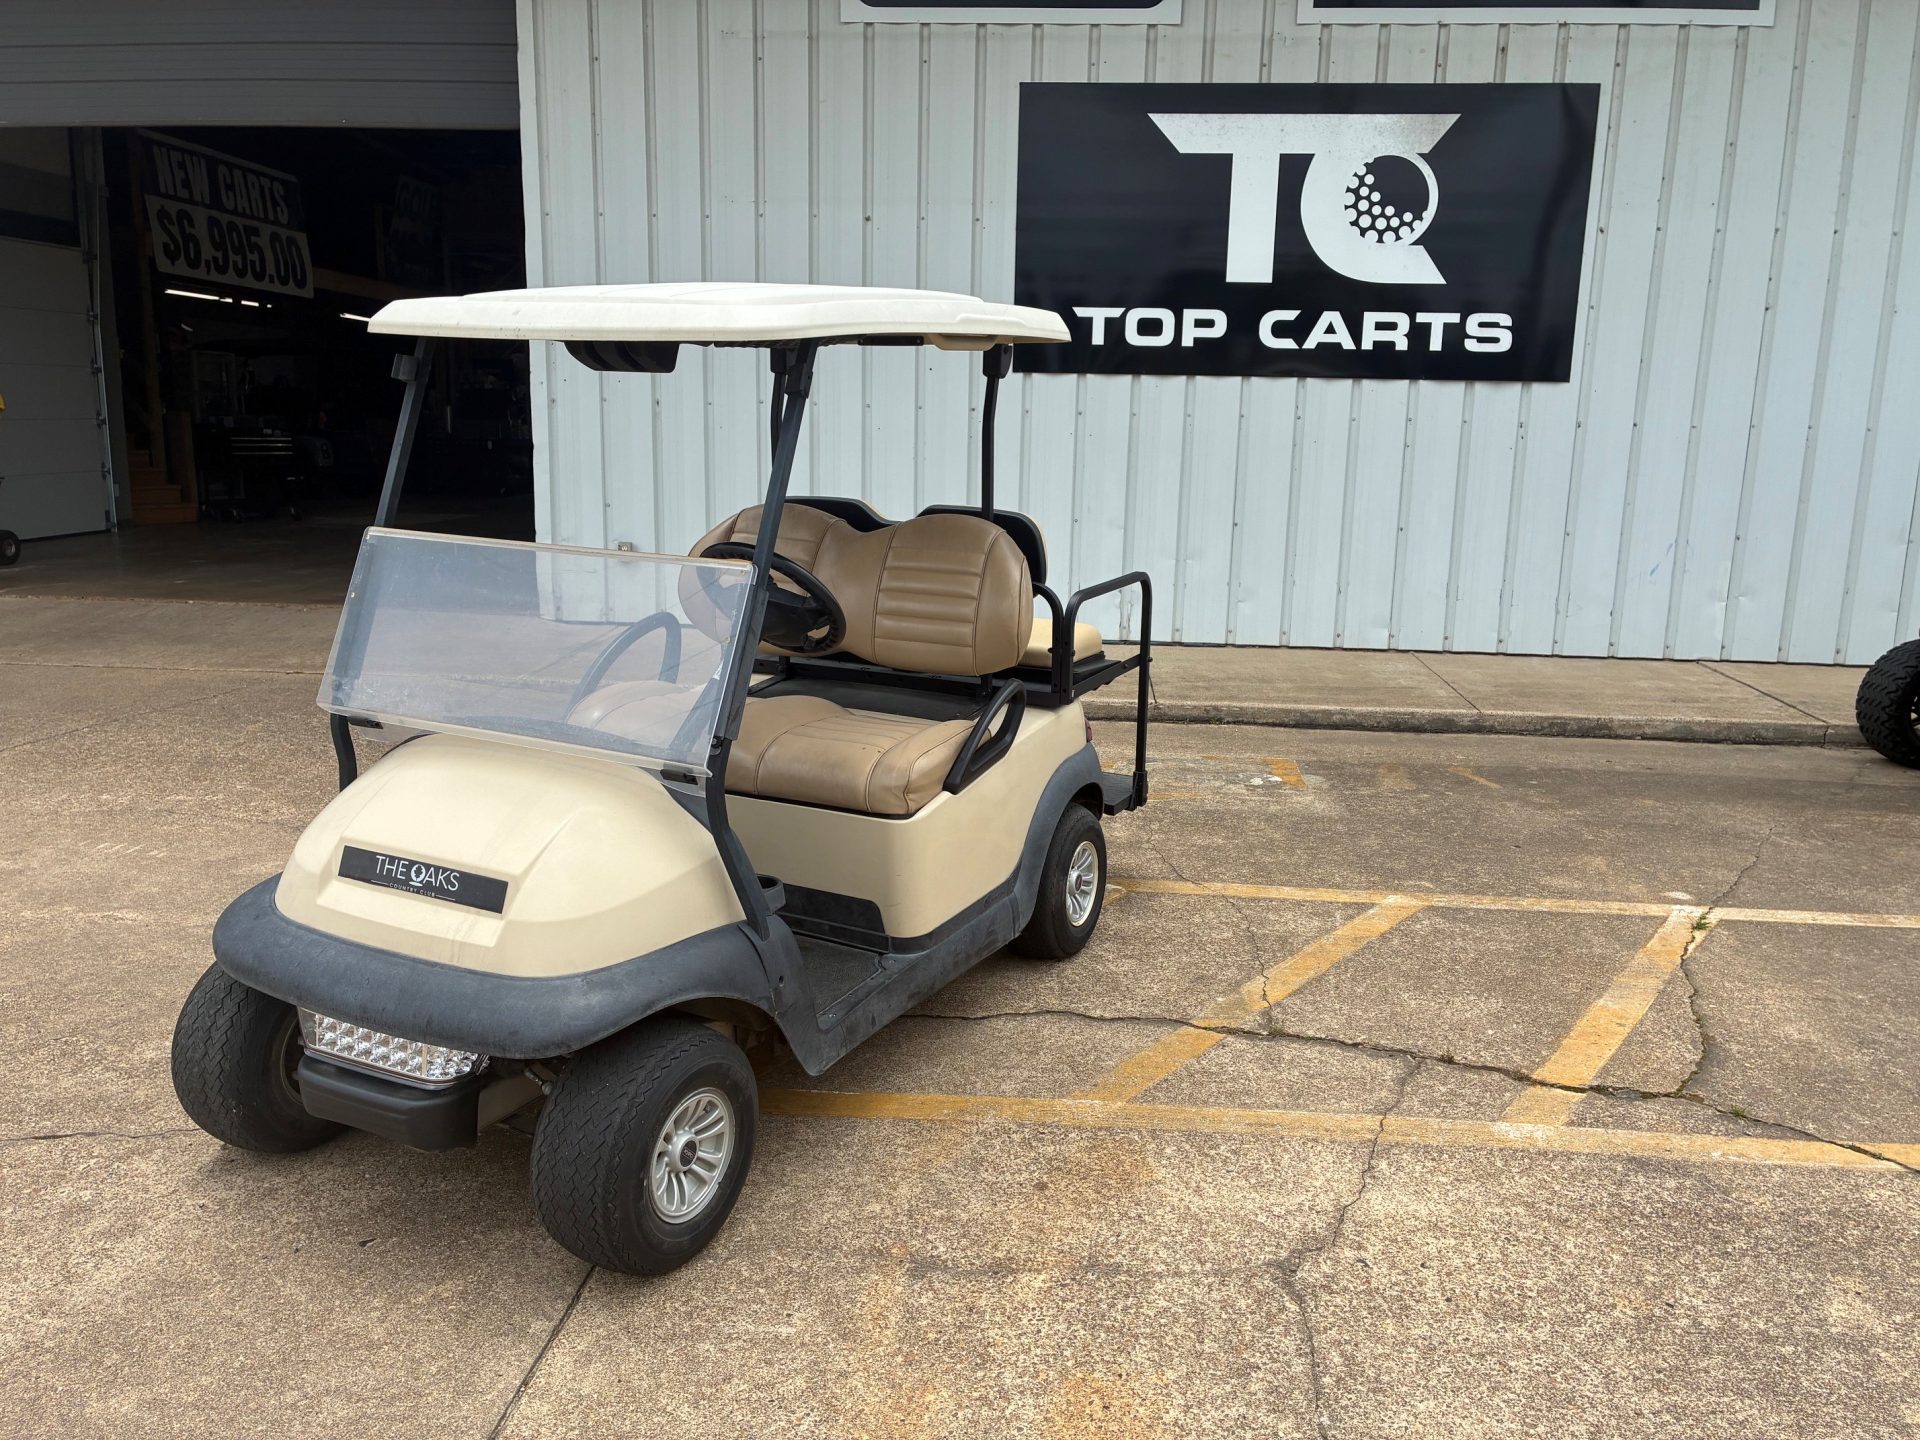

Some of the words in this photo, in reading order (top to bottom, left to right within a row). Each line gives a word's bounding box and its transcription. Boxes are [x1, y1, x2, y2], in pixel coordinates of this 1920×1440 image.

[153, 145, 210, 204] NEW
[218, 163, 289, 225] CARTS
[156, 204, 308, 290] $6,995.00
[1071, 306, 1228, 348] TOP
[1258, 309, 1513, 353] CARTS
[376, 855, 409, 880] THE
[409, 863, 460, 892] OAKS
[389, 882, 418, 894] COUNTRY
[419, 889, 436, 898] CLUB
